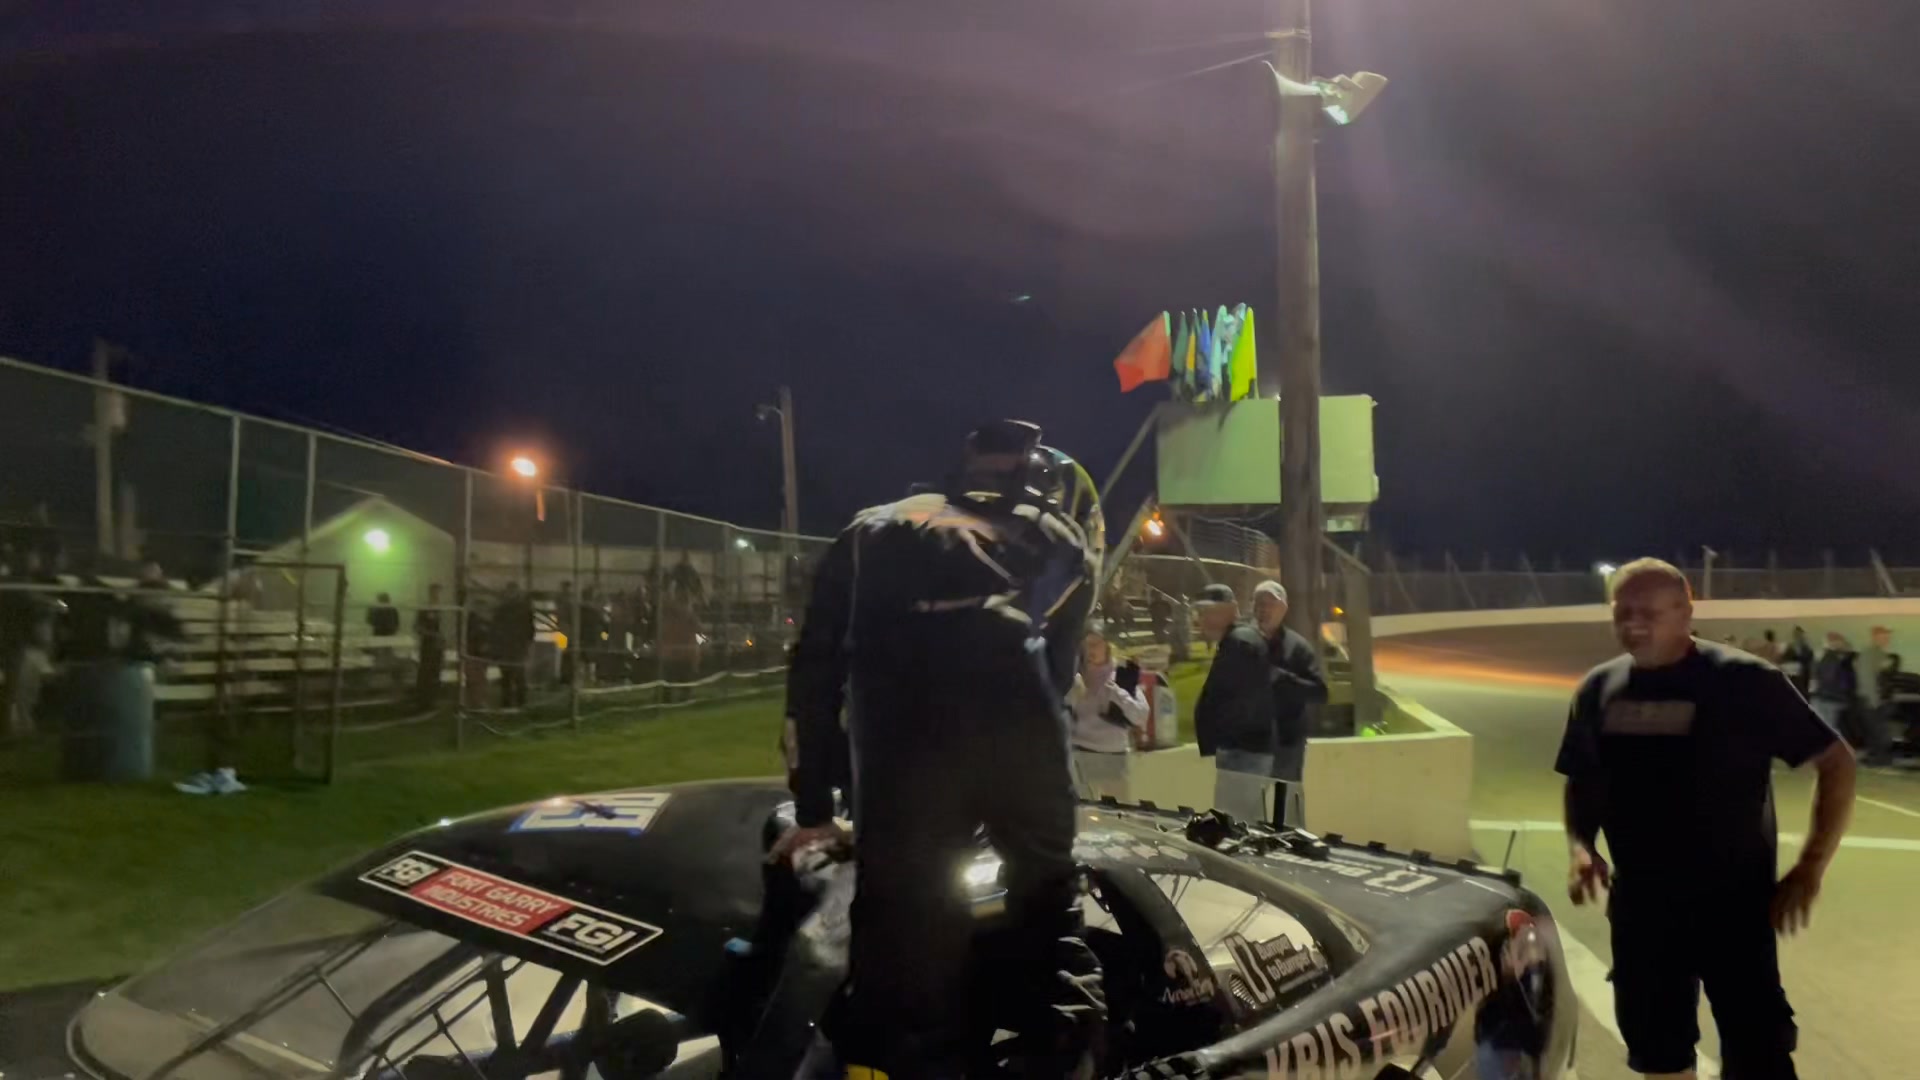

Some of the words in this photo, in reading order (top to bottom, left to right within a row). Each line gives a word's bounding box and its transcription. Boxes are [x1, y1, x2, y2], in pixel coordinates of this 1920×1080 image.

[422, 885, 531, 927] INDUSTRIES
[440, 870, 494, 893] FORT
[485, 887, 560, 914] GARRY
[546, 912, 638, 952] FGI
[1358, 936, 1498, 1065] FOURNIER
